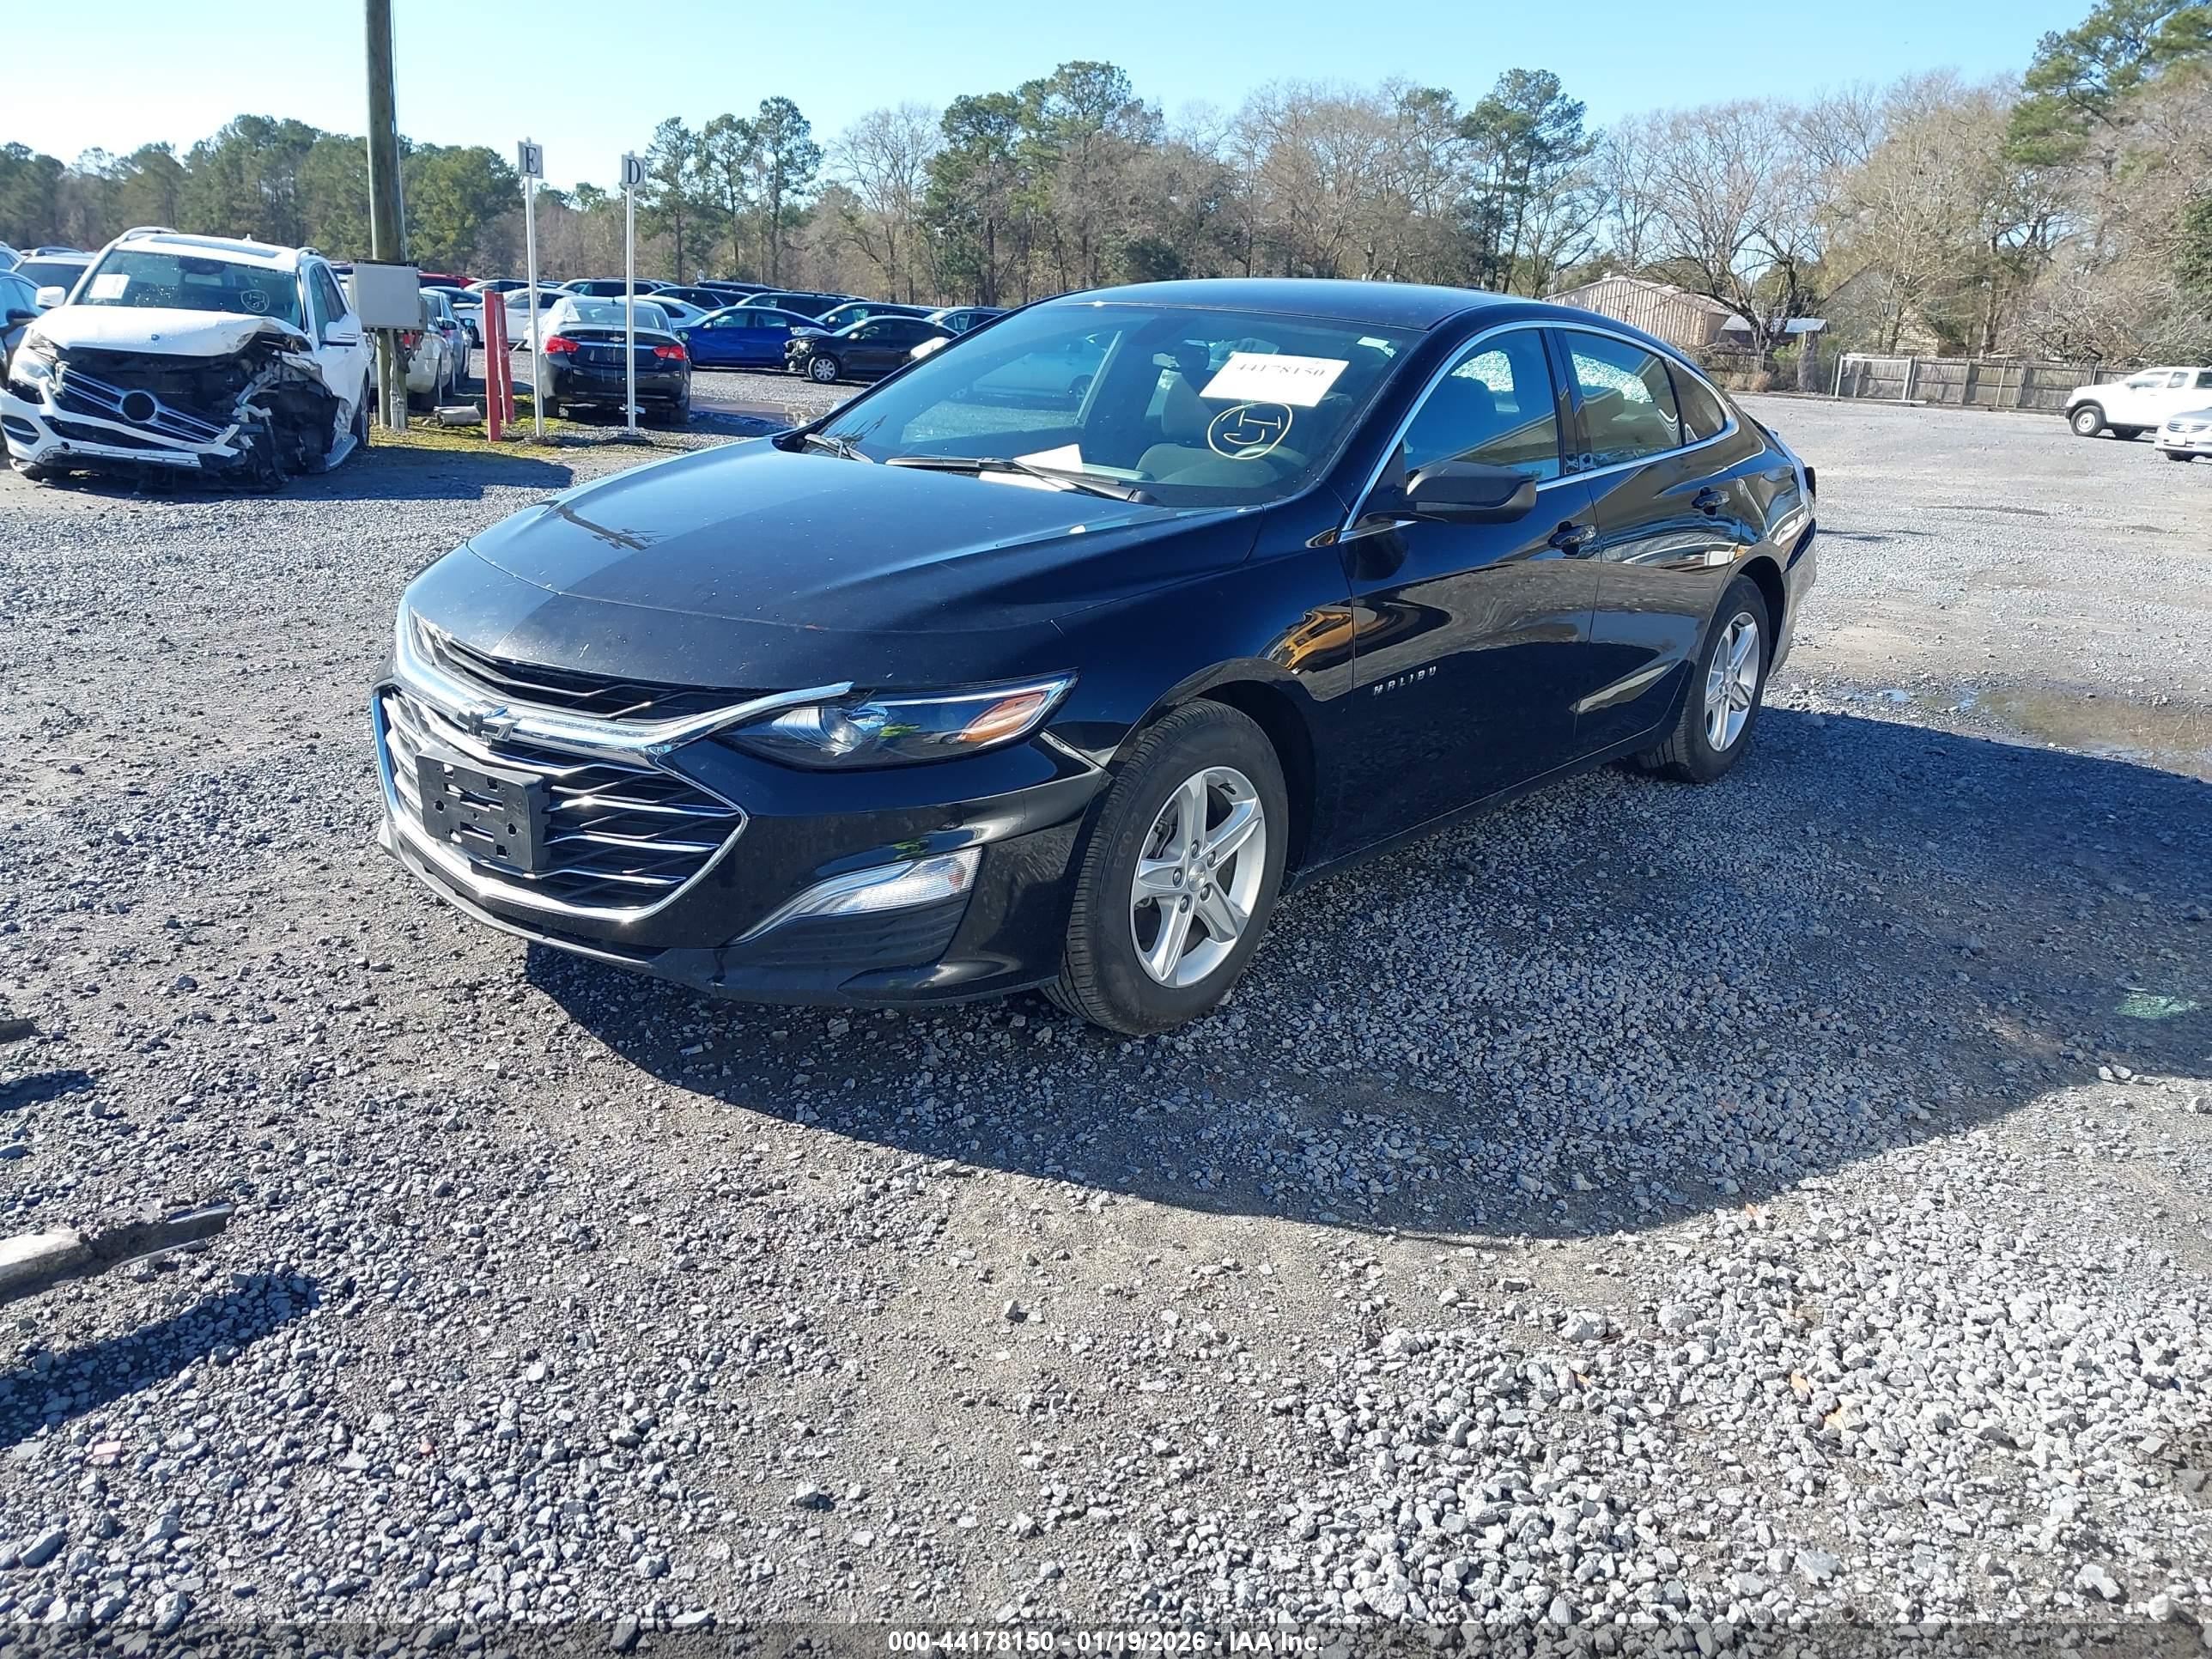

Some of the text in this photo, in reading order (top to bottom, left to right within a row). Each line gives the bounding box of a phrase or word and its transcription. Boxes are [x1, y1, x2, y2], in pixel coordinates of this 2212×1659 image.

[525, 146, 538, 174] E
[627, 159, 641, 185] D
[1373, 665, 1437, 696] MALIBU
